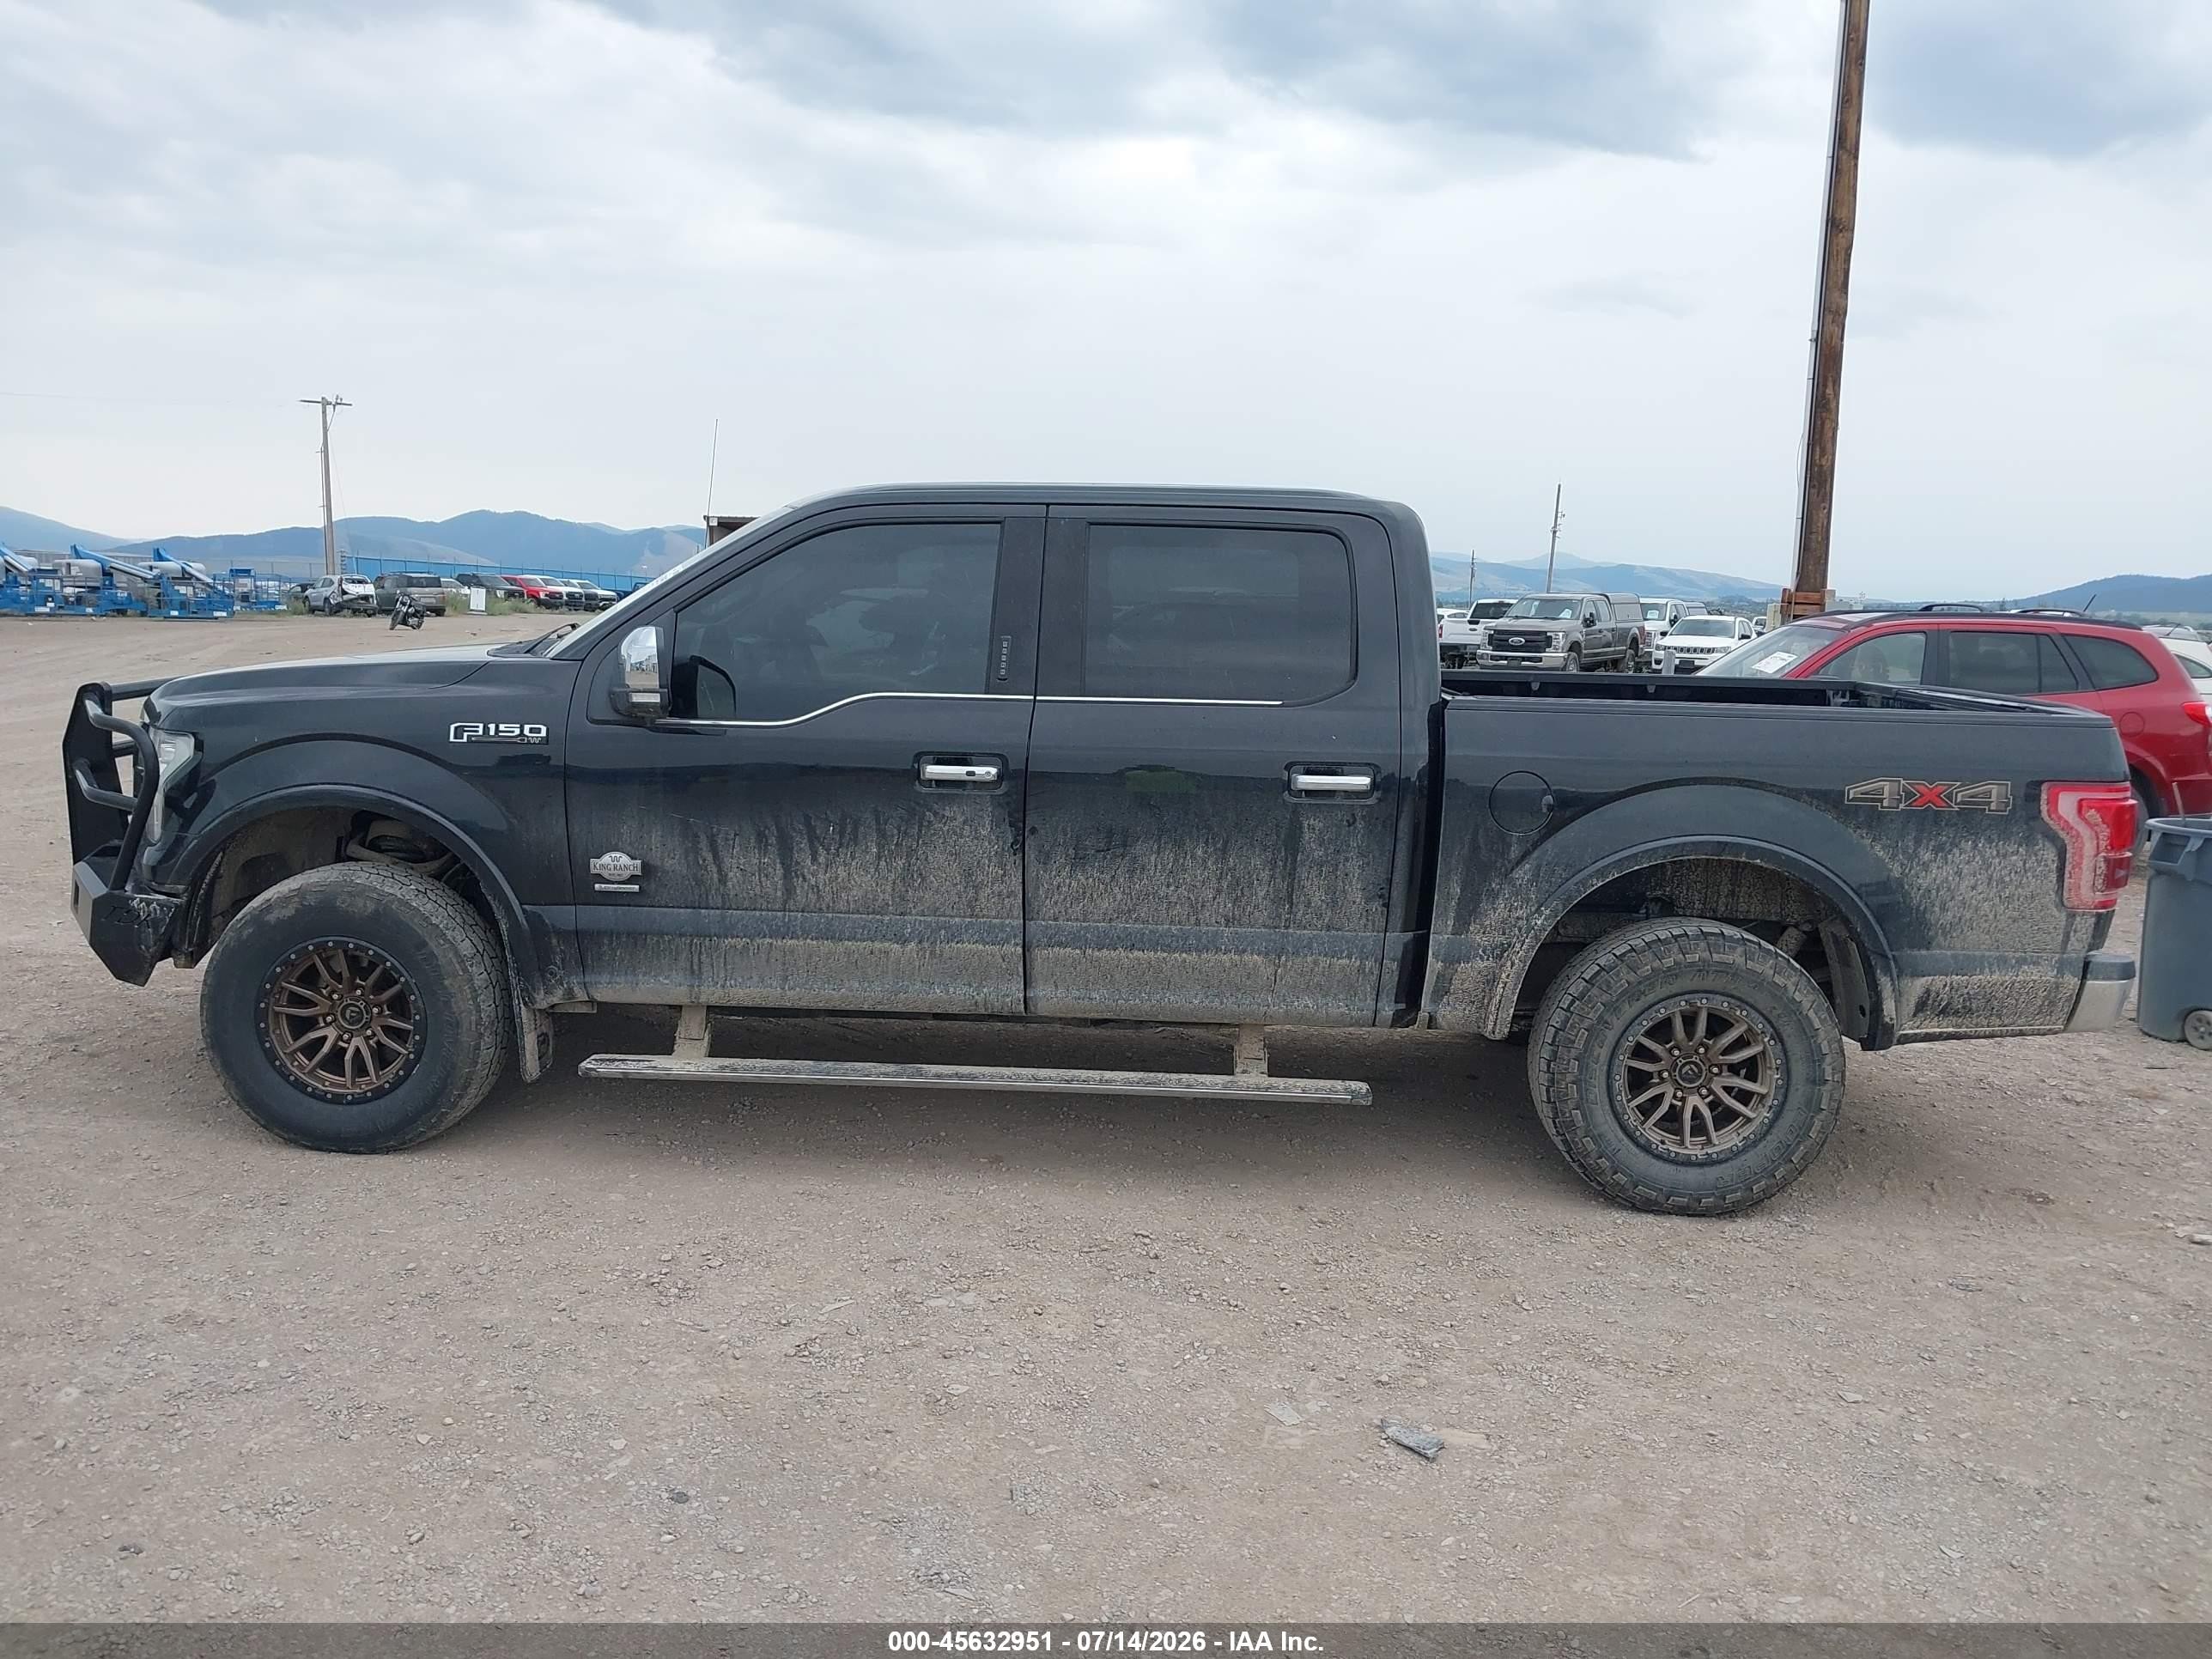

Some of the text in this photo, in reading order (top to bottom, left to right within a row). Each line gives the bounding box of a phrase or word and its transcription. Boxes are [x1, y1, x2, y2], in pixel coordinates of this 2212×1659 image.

[449, 722, 547, 743] F150
[592, 861, 639, 872] KING RANCH
[1716, 1107, 1808, 1188] COOPER
